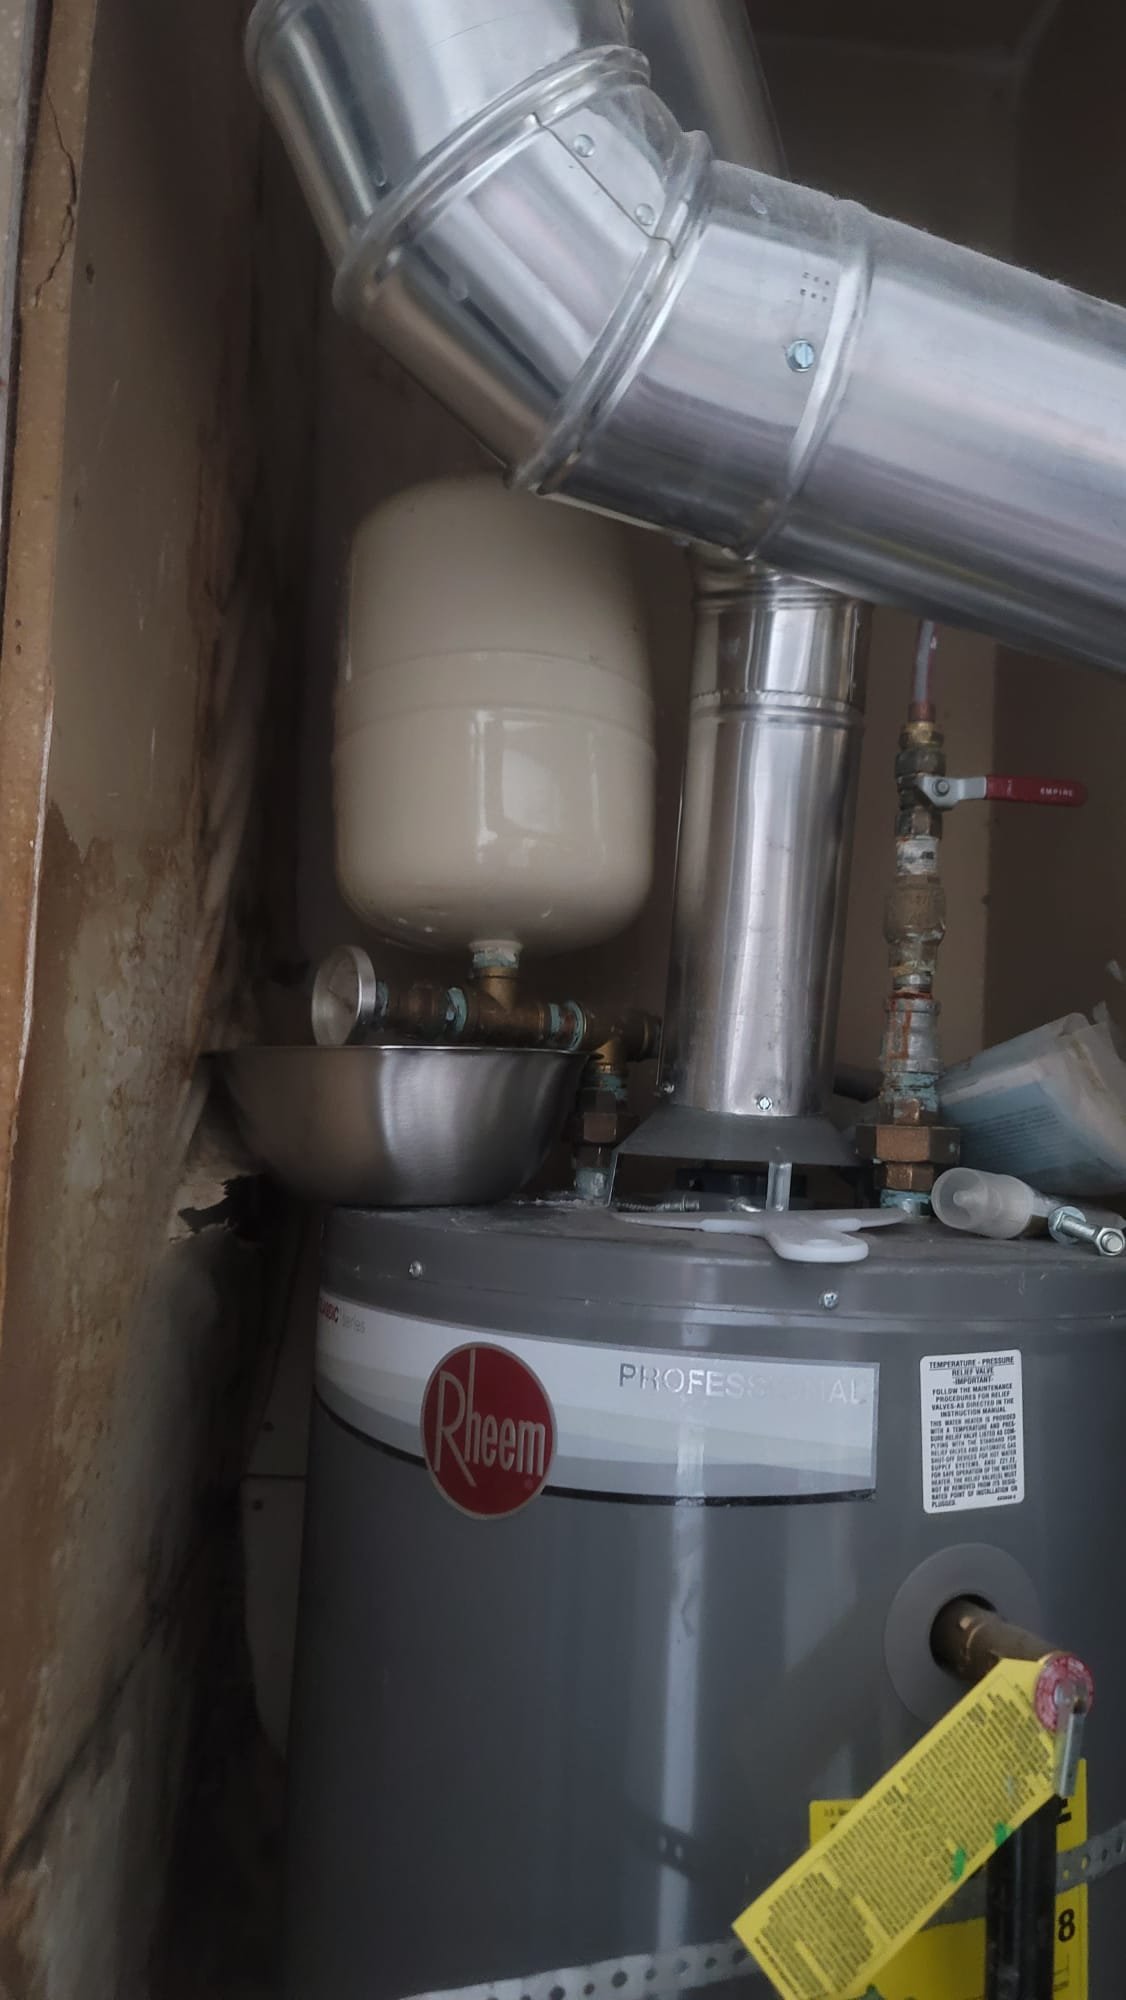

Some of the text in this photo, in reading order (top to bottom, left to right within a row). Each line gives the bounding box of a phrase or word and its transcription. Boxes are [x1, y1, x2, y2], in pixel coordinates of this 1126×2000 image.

[1040, 787, 1073, 798] EMPIRE
[929, 1359, 976, 1369] TEMPERATURE
[982, 1356, 1014, 1365] PRESSURE
[952, 1367, 993, 1376] RELIEF VALVE
[933, 1388, 958, 1396] FOLLOW
[973, 1383, 1012, 1392] MAINTENANCE
[936, 1394, 976, 1402] PROCEDURES
[932, 1403, 954, 1411] VALVES
[966, 1400, 995, 1408] DIRECTED
[434, 1349, 546, 1487] Rheem
[941, 1409, 980, 1417] INSTRUCTION
[993, 1413, 1016, 1421] PROVIDED
[953, 1424, 987, 1433] TEMPERATURE
[1058, 1908, 1075, 1942] 8
